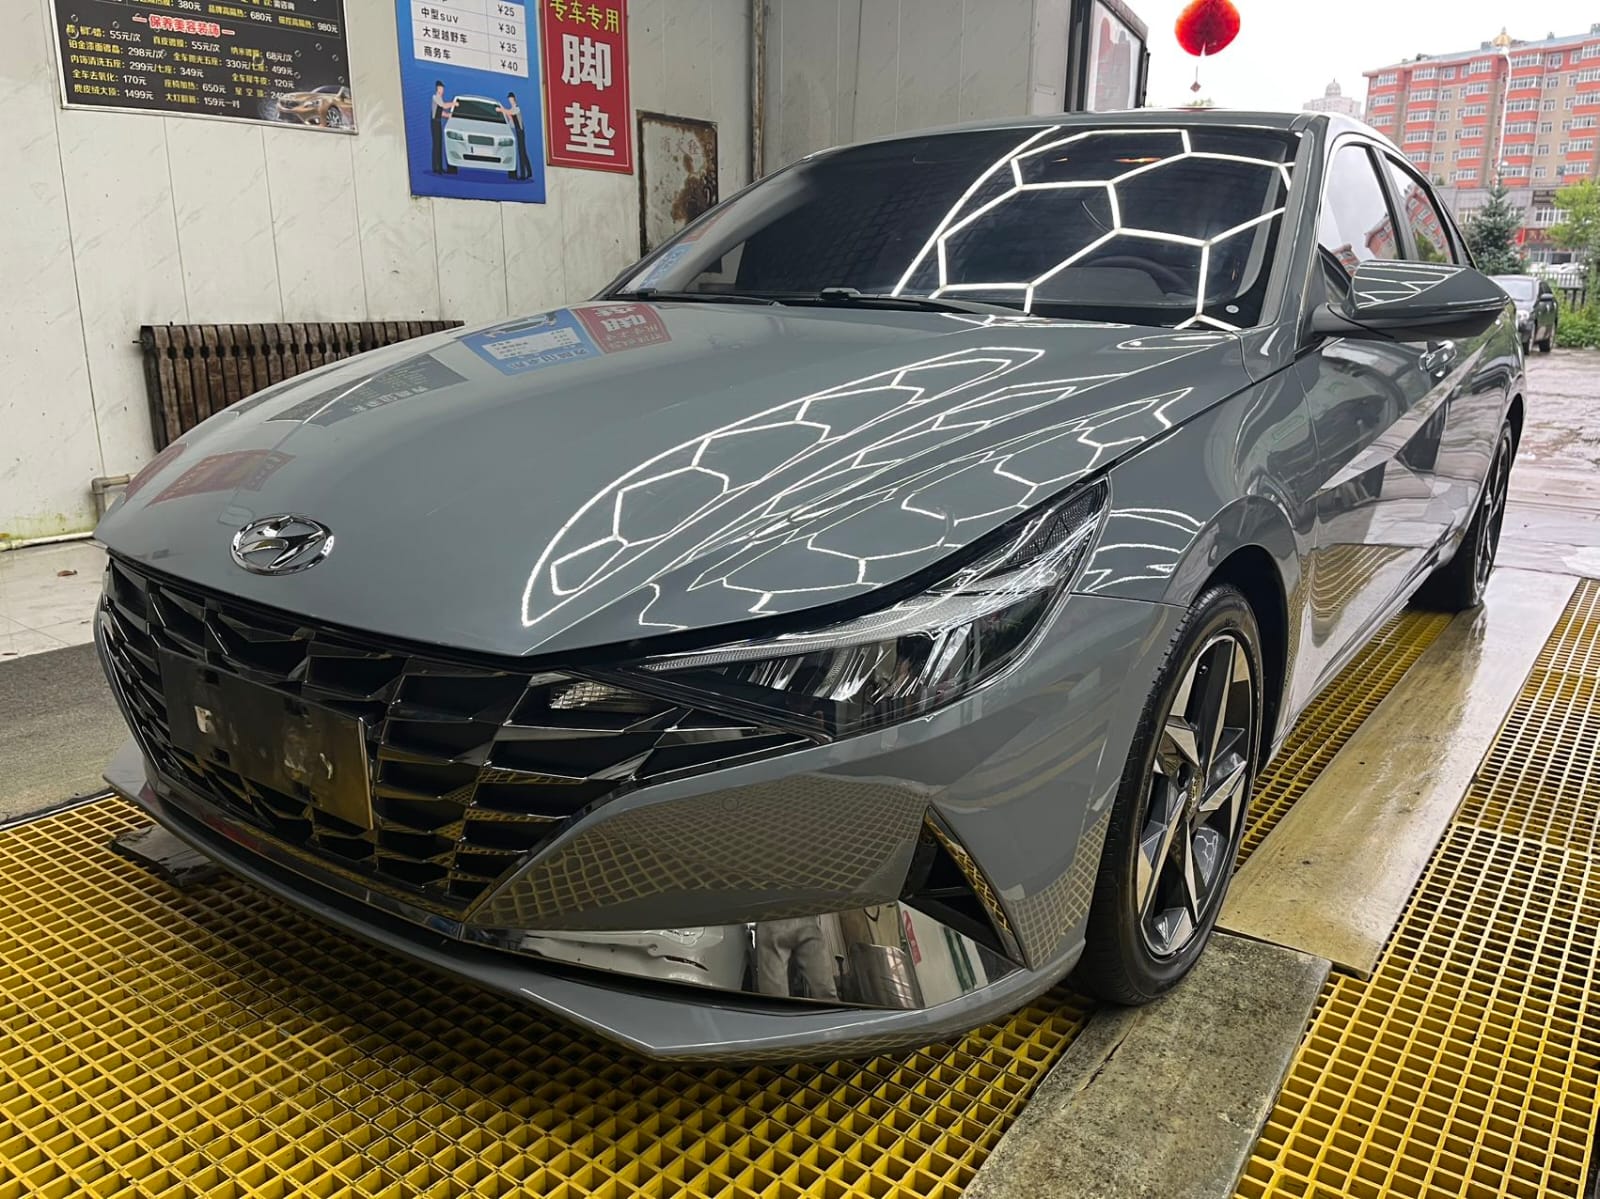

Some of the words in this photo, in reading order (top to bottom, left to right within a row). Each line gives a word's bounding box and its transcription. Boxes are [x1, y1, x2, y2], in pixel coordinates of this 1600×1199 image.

[497, 4, 515, 17] ¥25
[550, 0, 619, 34] 专车专用
[422, 26, 469, 44] 大型越野车
[498, 23, 516, 36] ¥30
[423, 45, 452, 60] 商务车
[499, 41, 518, 54] ¥35
[500, 59, 518, 72] ¥40
[561, 33, 616, 156] 脚垫
